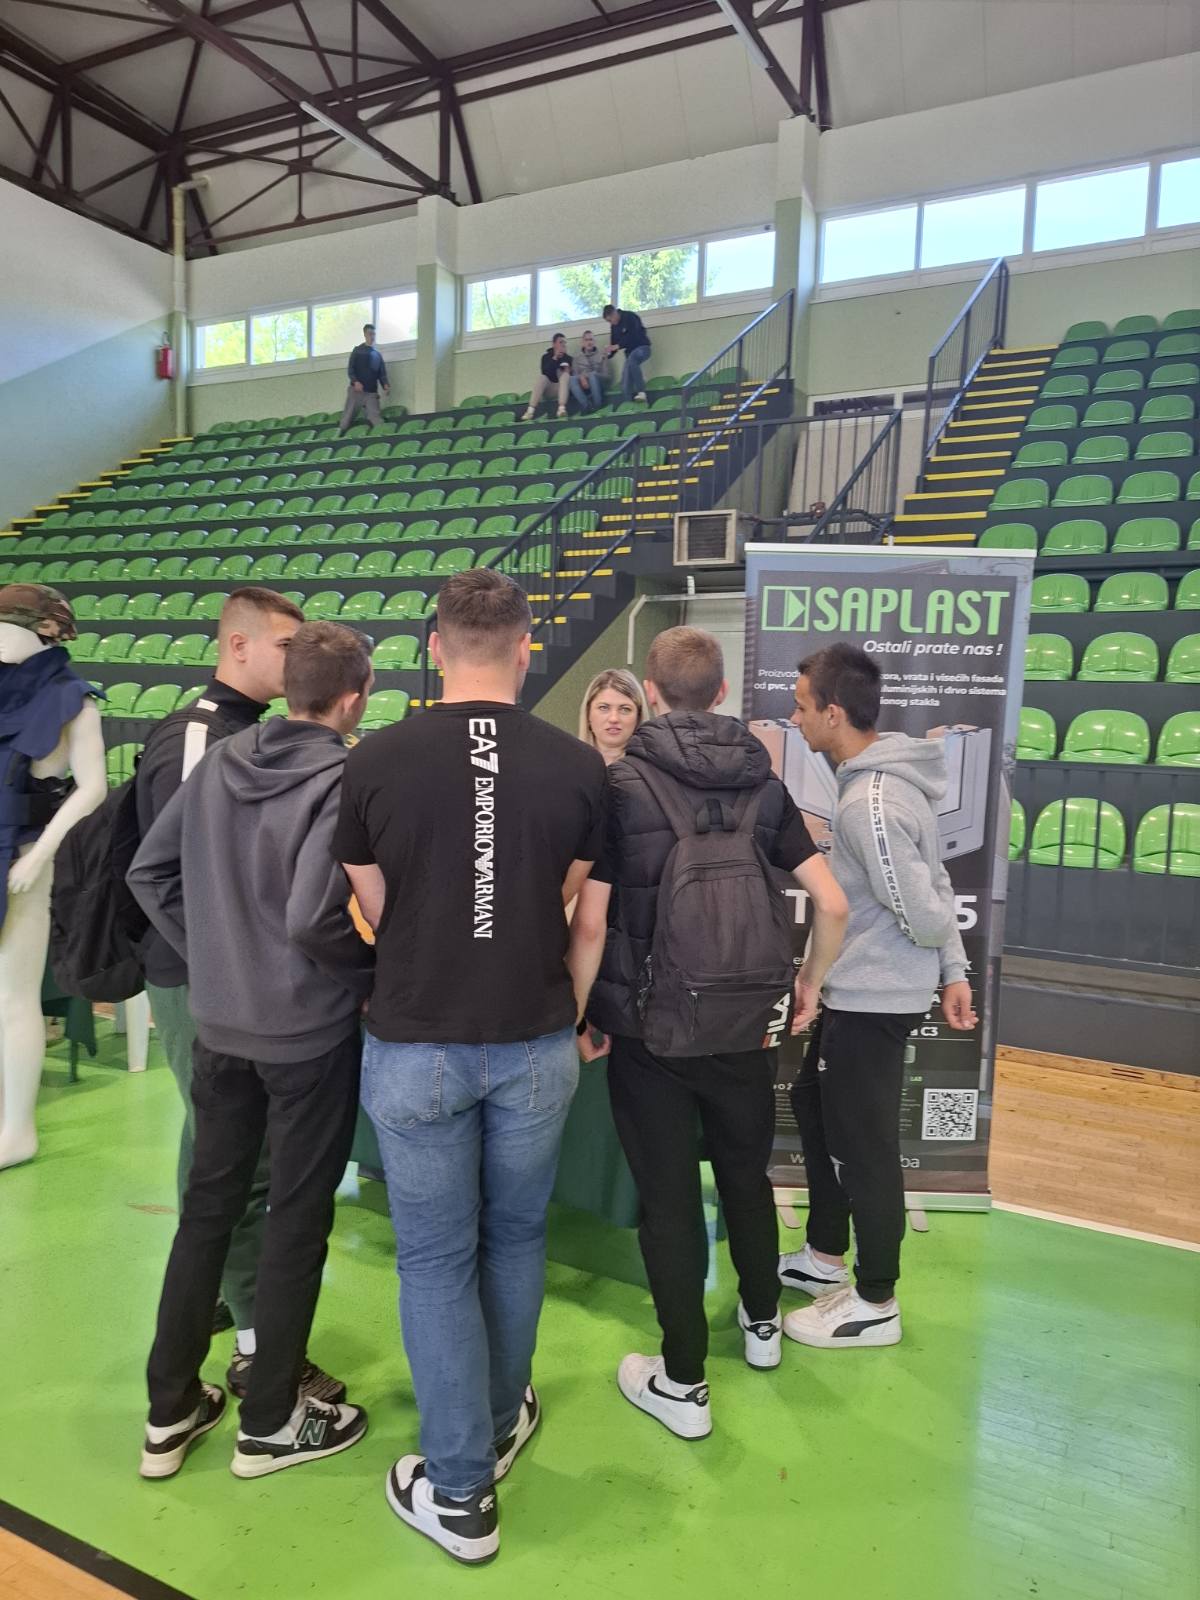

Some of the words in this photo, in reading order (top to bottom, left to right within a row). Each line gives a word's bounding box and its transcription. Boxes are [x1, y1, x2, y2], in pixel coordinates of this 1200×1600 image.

[813, 586, 1010, 636] SAPLAST
[863, 640, 912, 654] Ostali
[913, 643, 960, 656] prate
[962, 645, 994, 655] nas
[995, 643, 1003, 655] !
[753, 681, 767, 690] od
[768, 683, 789, 691] pvc,
[944, 686, 967, 695] drvo
[758, 669, 800, 678] Proizvod
[902, 674, 929, 682] vrata
[468, 718, 499, 774] EA7
[474, 777, 495, 853] EMPORIO
[473, 869, 495, 939] ARMANI
[762, 992, 791, 1049] FILA
